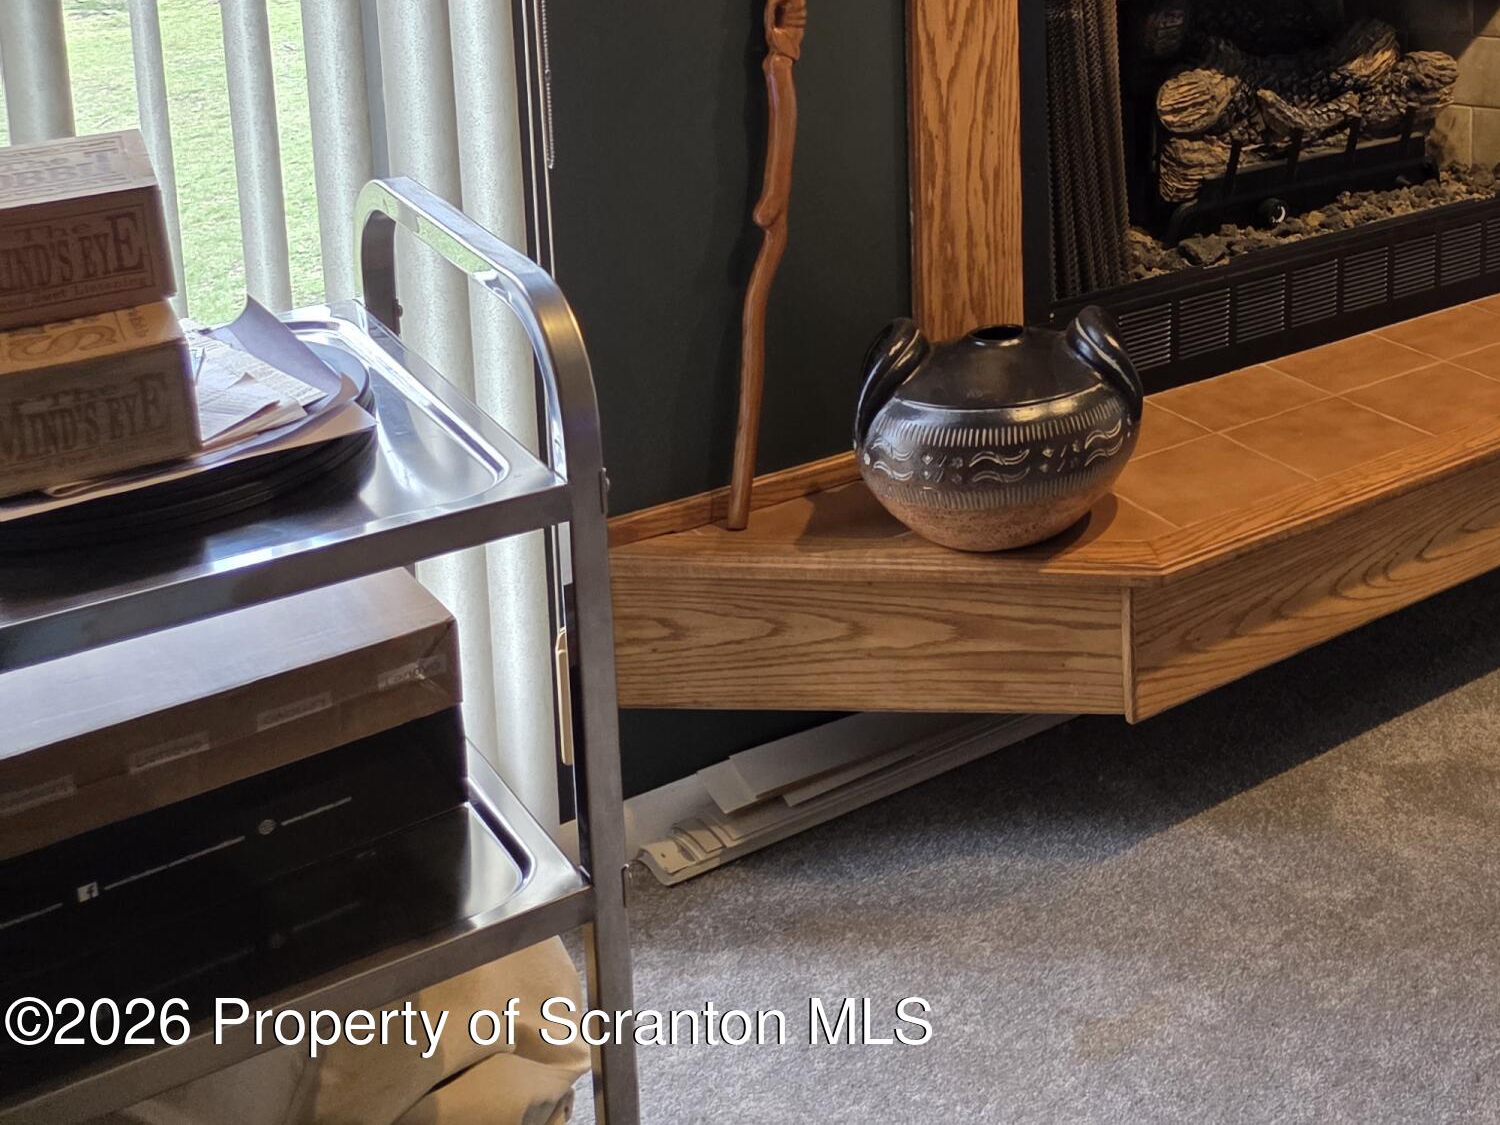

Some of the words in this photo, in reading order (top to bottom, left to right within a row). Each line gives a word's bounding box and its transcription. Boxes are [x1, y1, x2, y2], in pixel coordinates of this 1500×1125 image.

[0, 240, 73, 291] IND'S
[78, 212, 145, 278] EYE
[14, 223, 91, 242] The
[107, 372, 170, 440] EYE
